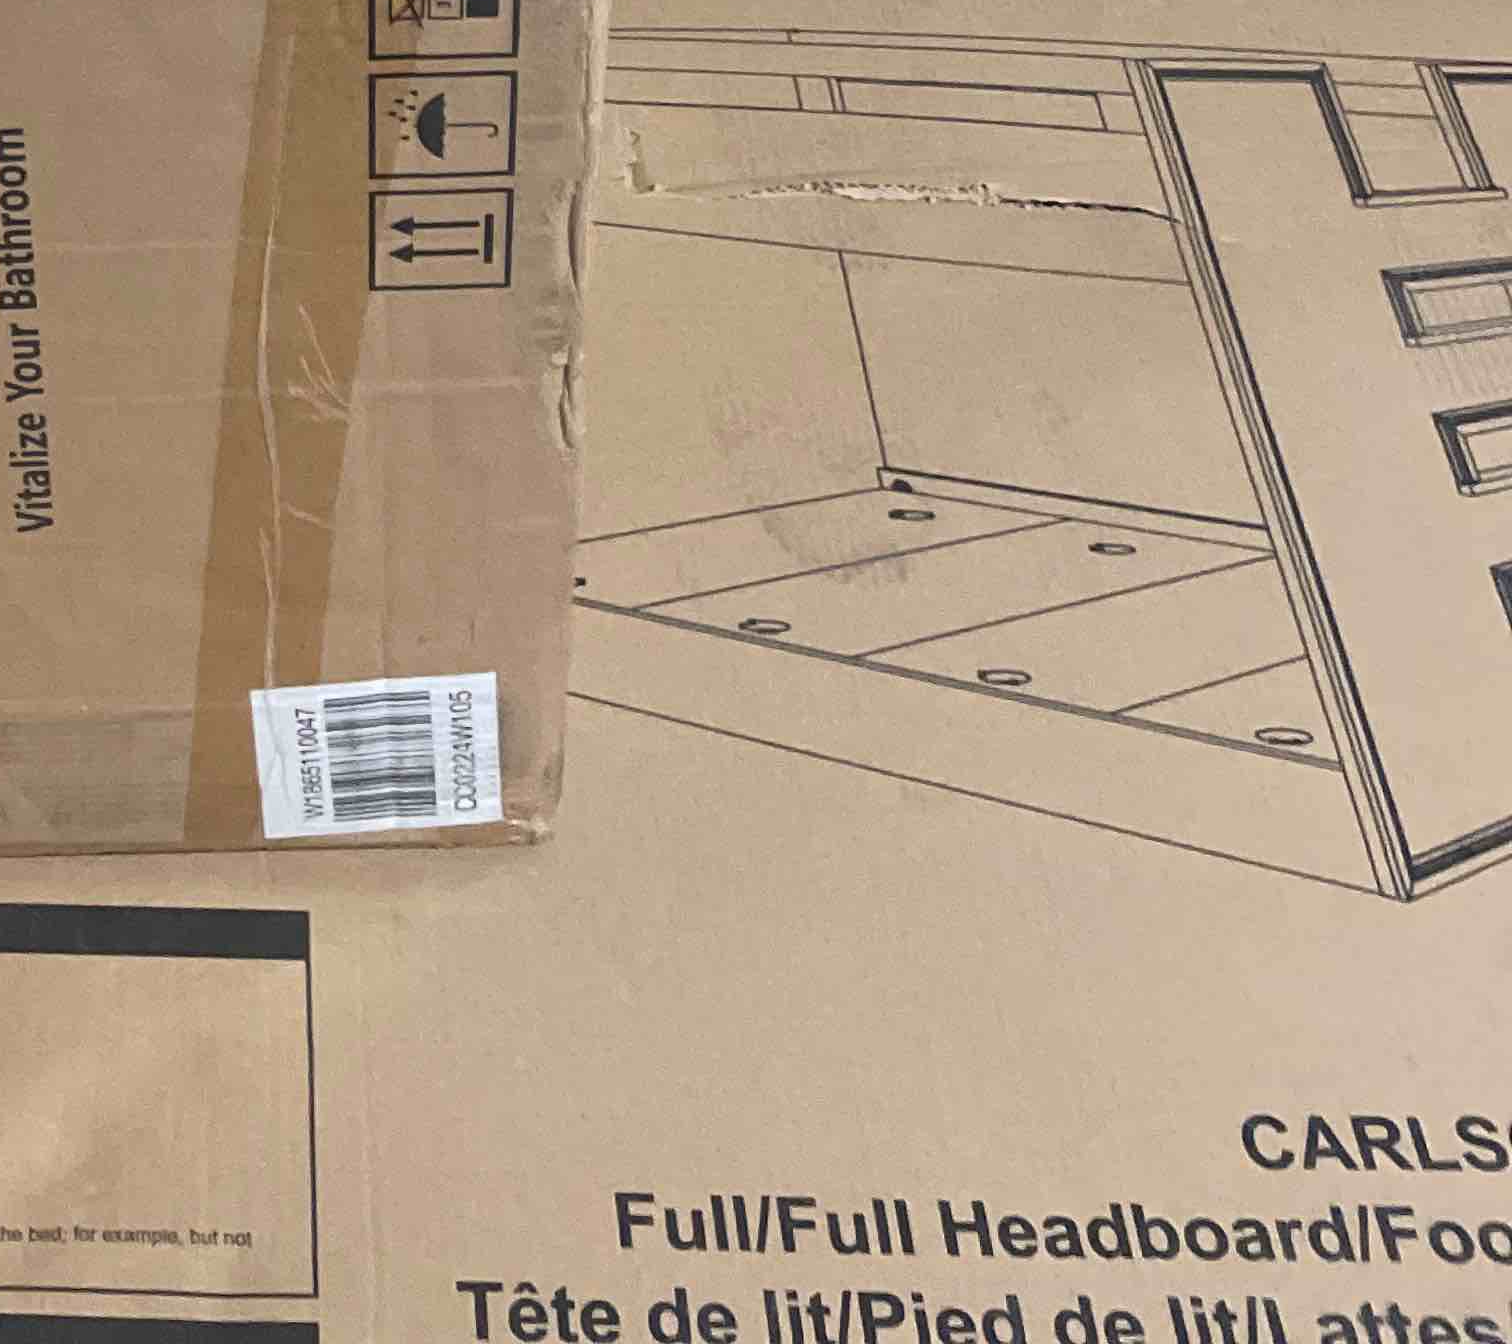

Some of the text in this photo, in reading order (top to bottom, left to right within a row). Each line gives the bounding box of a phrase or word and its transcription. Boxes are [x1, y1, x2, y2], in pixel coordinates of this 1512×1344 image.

[4, 322, 46, 403] Your
[8, 412, 55, 533] Vitalize
[1240, 1114, 1512, 1173] CARLS
[613, 1191, 917, 1257] Full/Full
[455, 1279, 623, 1344] Tête
[647, 1286, 740, 1344] de
